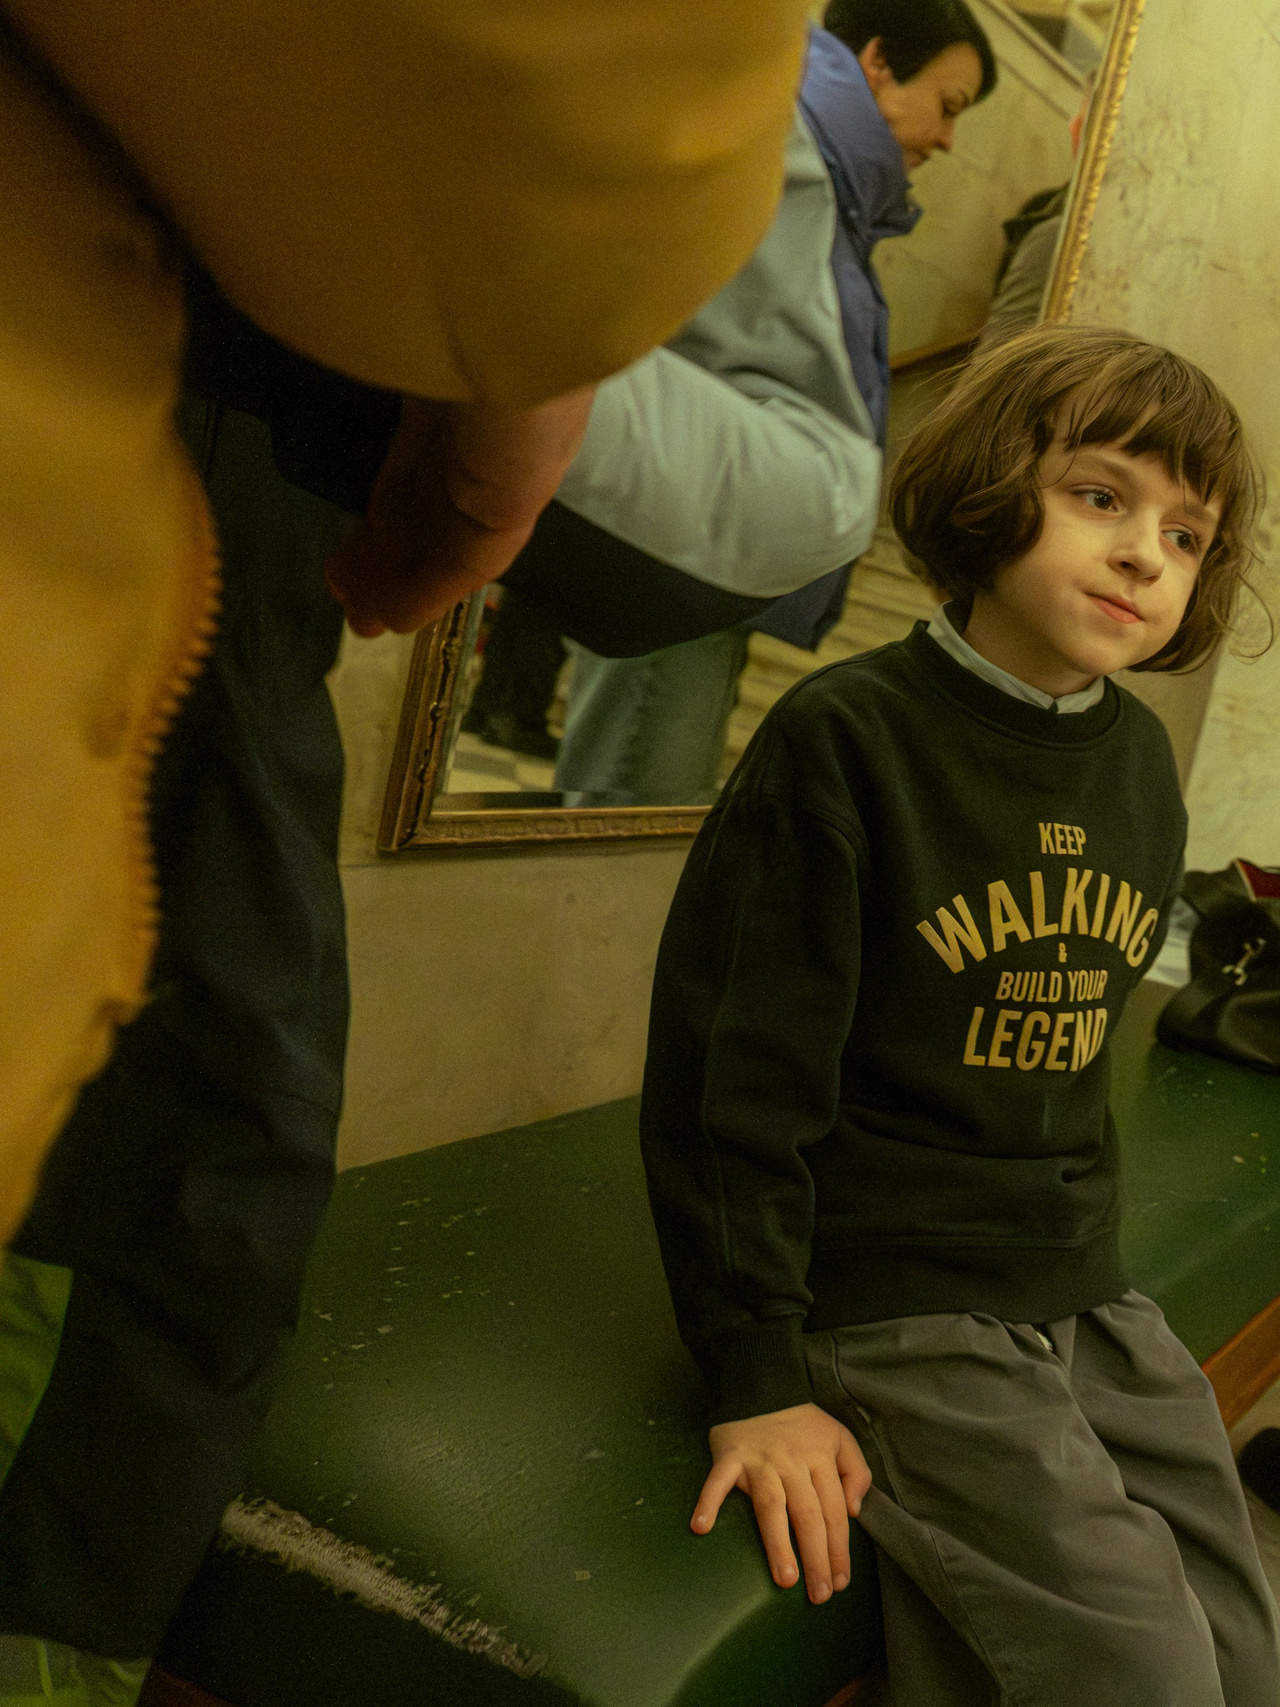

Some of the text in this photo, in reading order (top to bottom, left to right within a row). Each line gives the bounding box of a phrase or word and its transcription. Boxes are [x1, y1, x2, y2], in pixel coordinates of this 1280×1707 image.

[1039, 822, 1086, 855] KEEP
[916, 867, 1159, 974] WALKING
[1058, 942, 1067, 963] &
[995, 969, 1108, 1003] BUILD YOUR
[963, 1006, 1108, 1072] LEGEND
